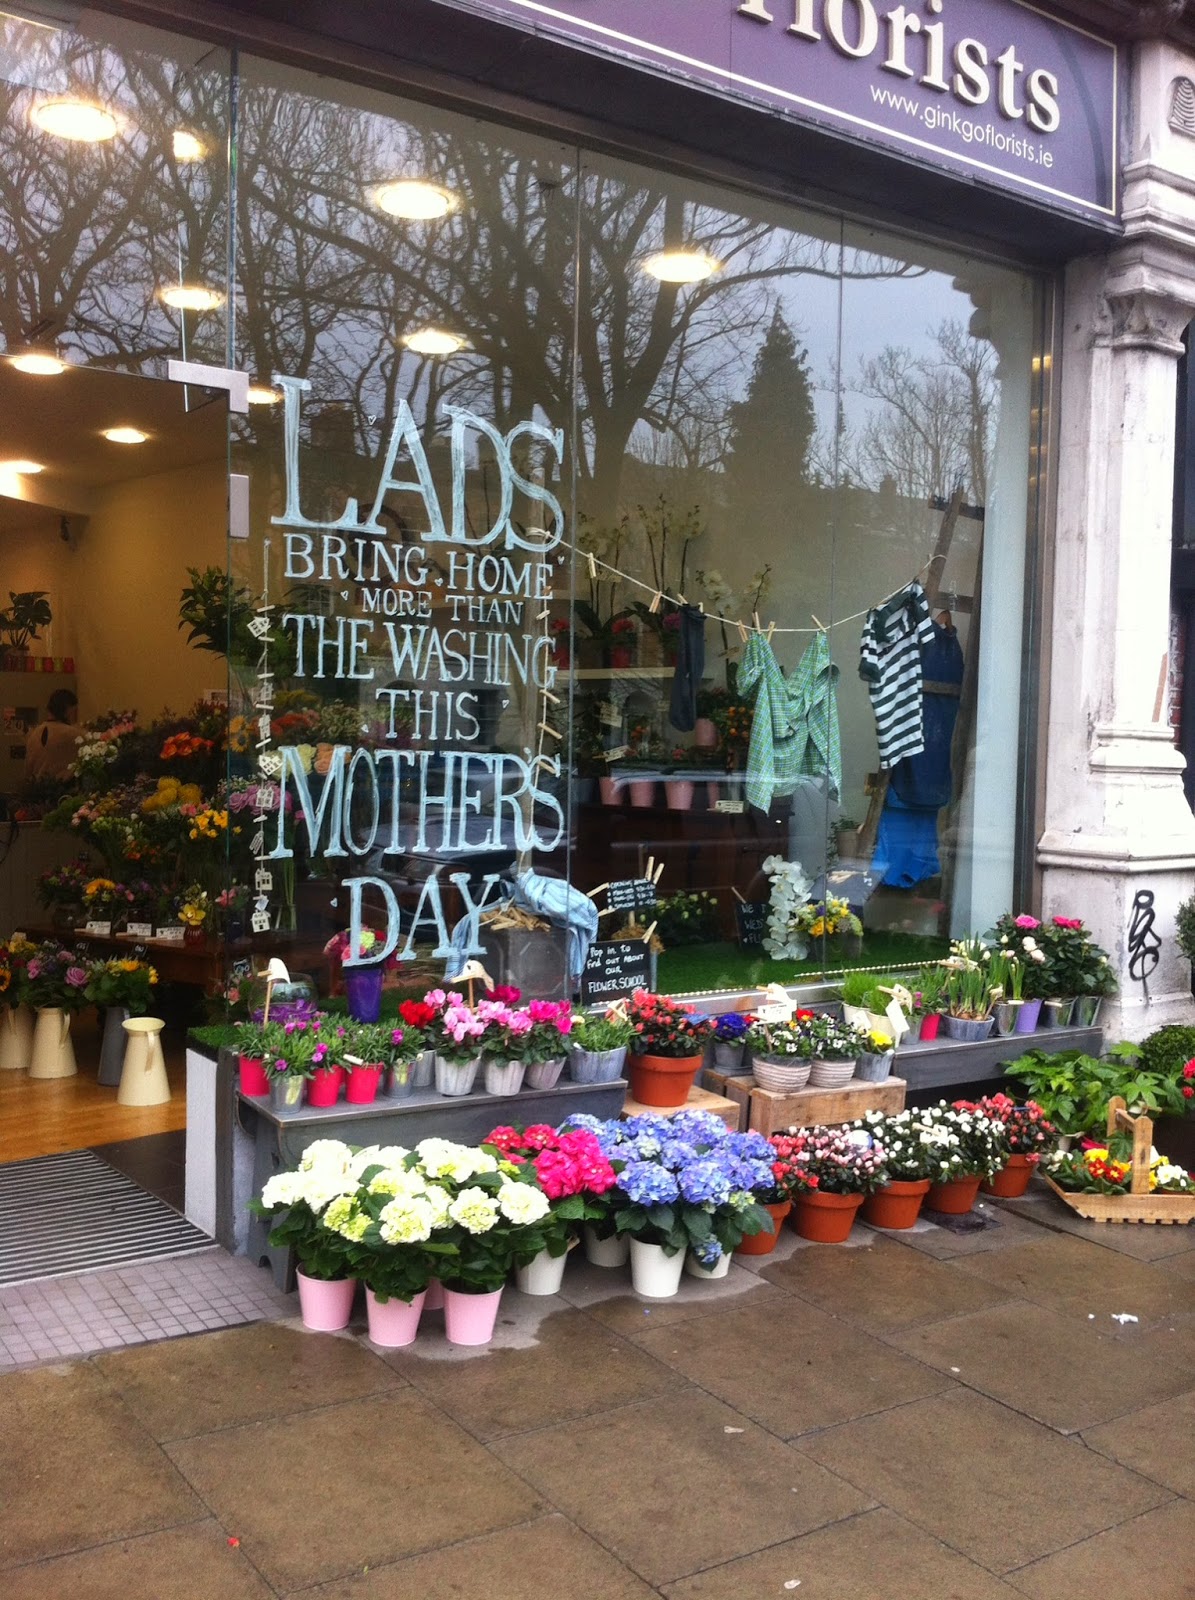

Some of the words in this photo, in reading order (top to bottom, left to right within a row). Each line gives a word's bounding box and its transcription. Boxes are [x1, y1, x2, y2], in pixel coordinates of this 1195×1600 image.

[737, 0, 1061, 133] orists
[870, 85, 1053, 168] www.ginkgoflorists.ie
[271, 375, 564, 552] LADS
[283, 533, 429, 586] BRING
[446, 551, 553, 599] HOME
[361, 587, 432, 618] MORE
[445, 594, 524, 625] THAN
[282, 613, 374, 680] THE
[382, 621, 557, 688] WASHING
[375, 688, 480, 741] THIS
[341, 872, 500, 967] DAY
[590, 946, 604, 958] Pop
[588, 979, 619, 993] FLOWER
[619, 974, 648, 989] SCHOOL
[605, 965, 622, 975] OUR
